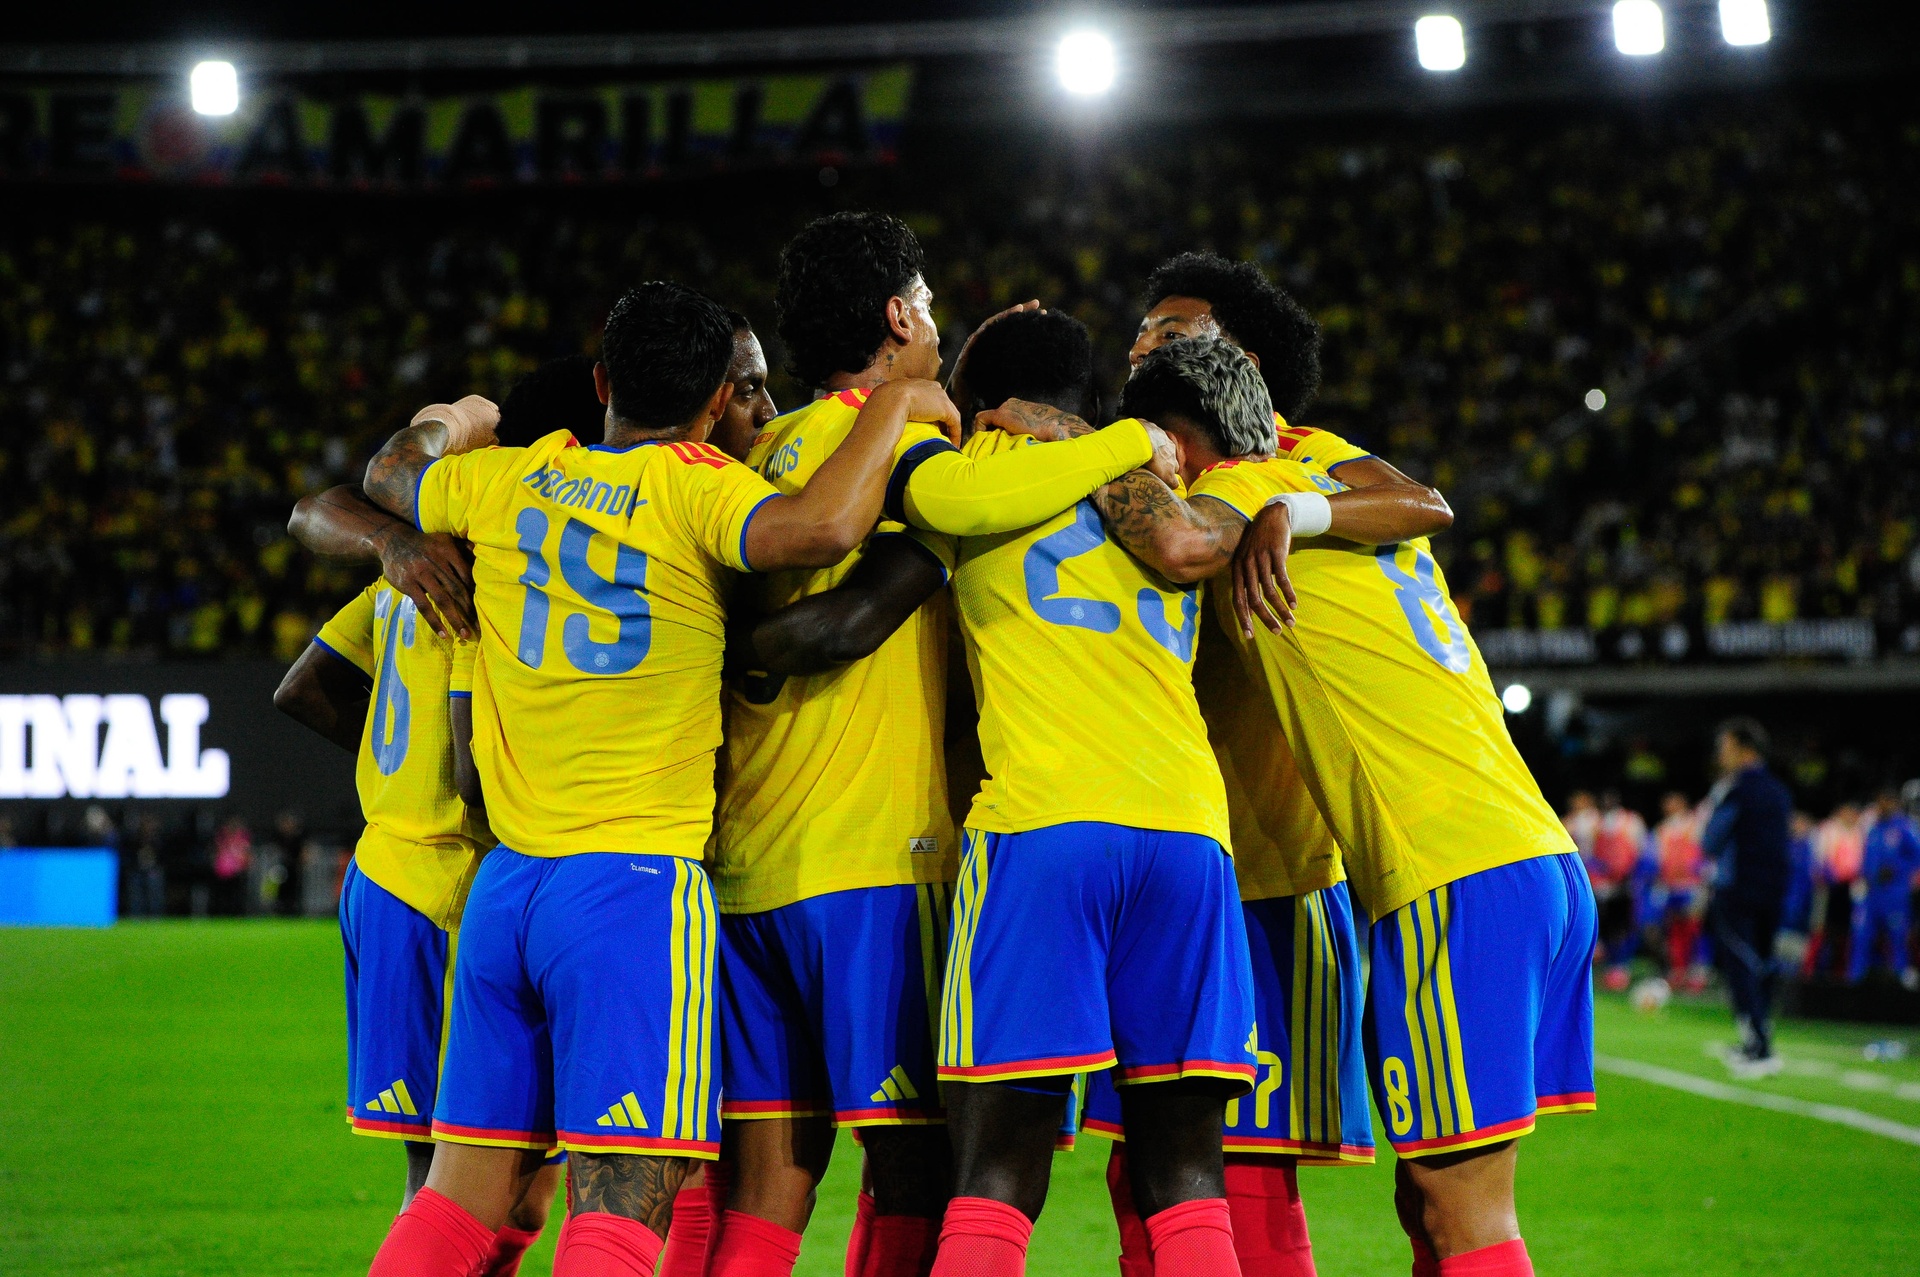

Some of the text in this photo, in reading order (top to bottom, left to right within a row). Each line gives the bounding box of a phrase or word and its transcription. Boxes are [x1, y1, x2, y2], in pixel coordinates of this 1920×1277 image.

[236, 80, 868, 180] AMARILLA
[515, 507, 652, 675] 19
[1375, 541, 1471, 673] 8
[1383, 1056, 1414, 1136] 8
